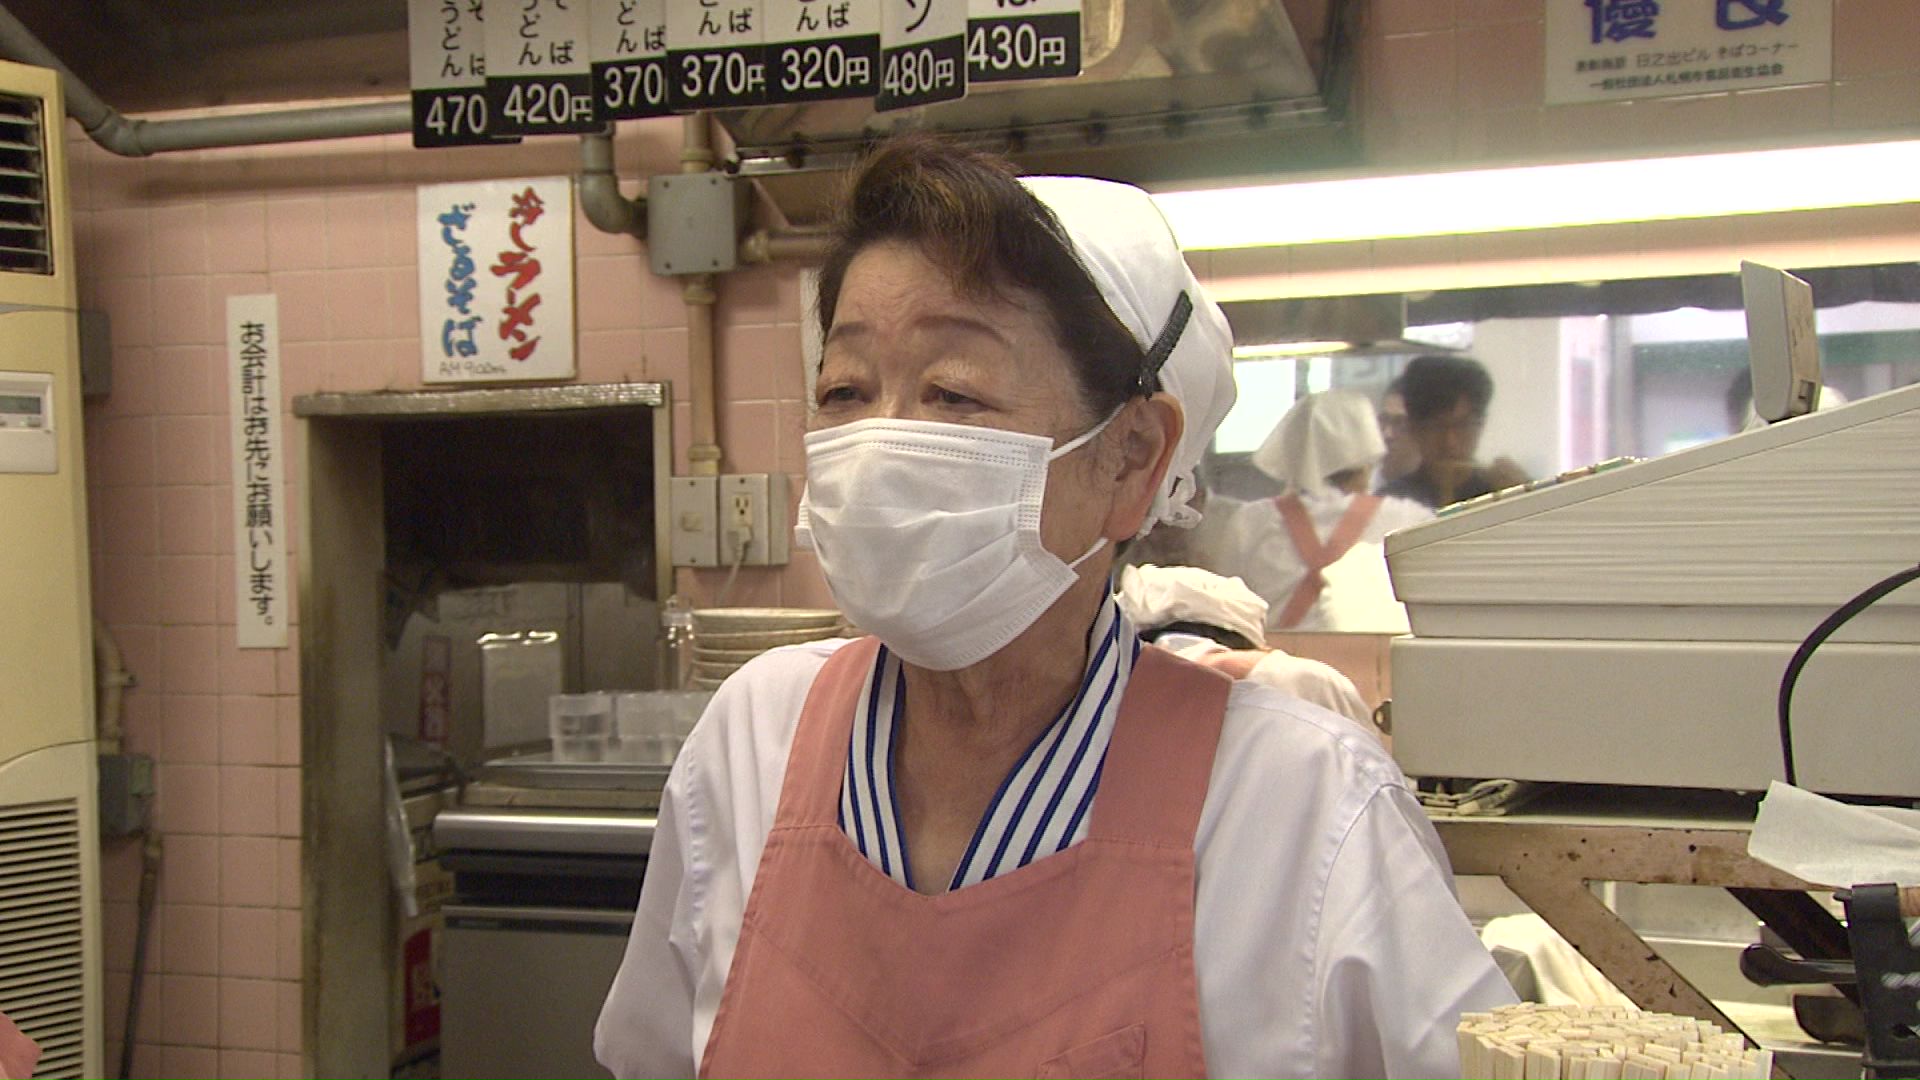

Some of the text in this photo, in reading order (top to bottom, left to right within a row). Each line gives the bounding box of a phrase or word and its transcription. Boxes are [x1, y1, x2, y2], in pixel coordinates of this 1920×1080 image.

[781, 44, 870, 92] 320円
[967, 22, 1066, 71] 430円
[604, 62, 664, 108] 370
[682, 51, 766, 98] 370円
[883, 47, 954, 97] 480円
[426, 94, 488, 136] 470
[503, 82, 593, 125] 420円
[437, 203, 483, 357] ざるそば
[239, 321, 274, 627] お会計はお先にお願いします。
